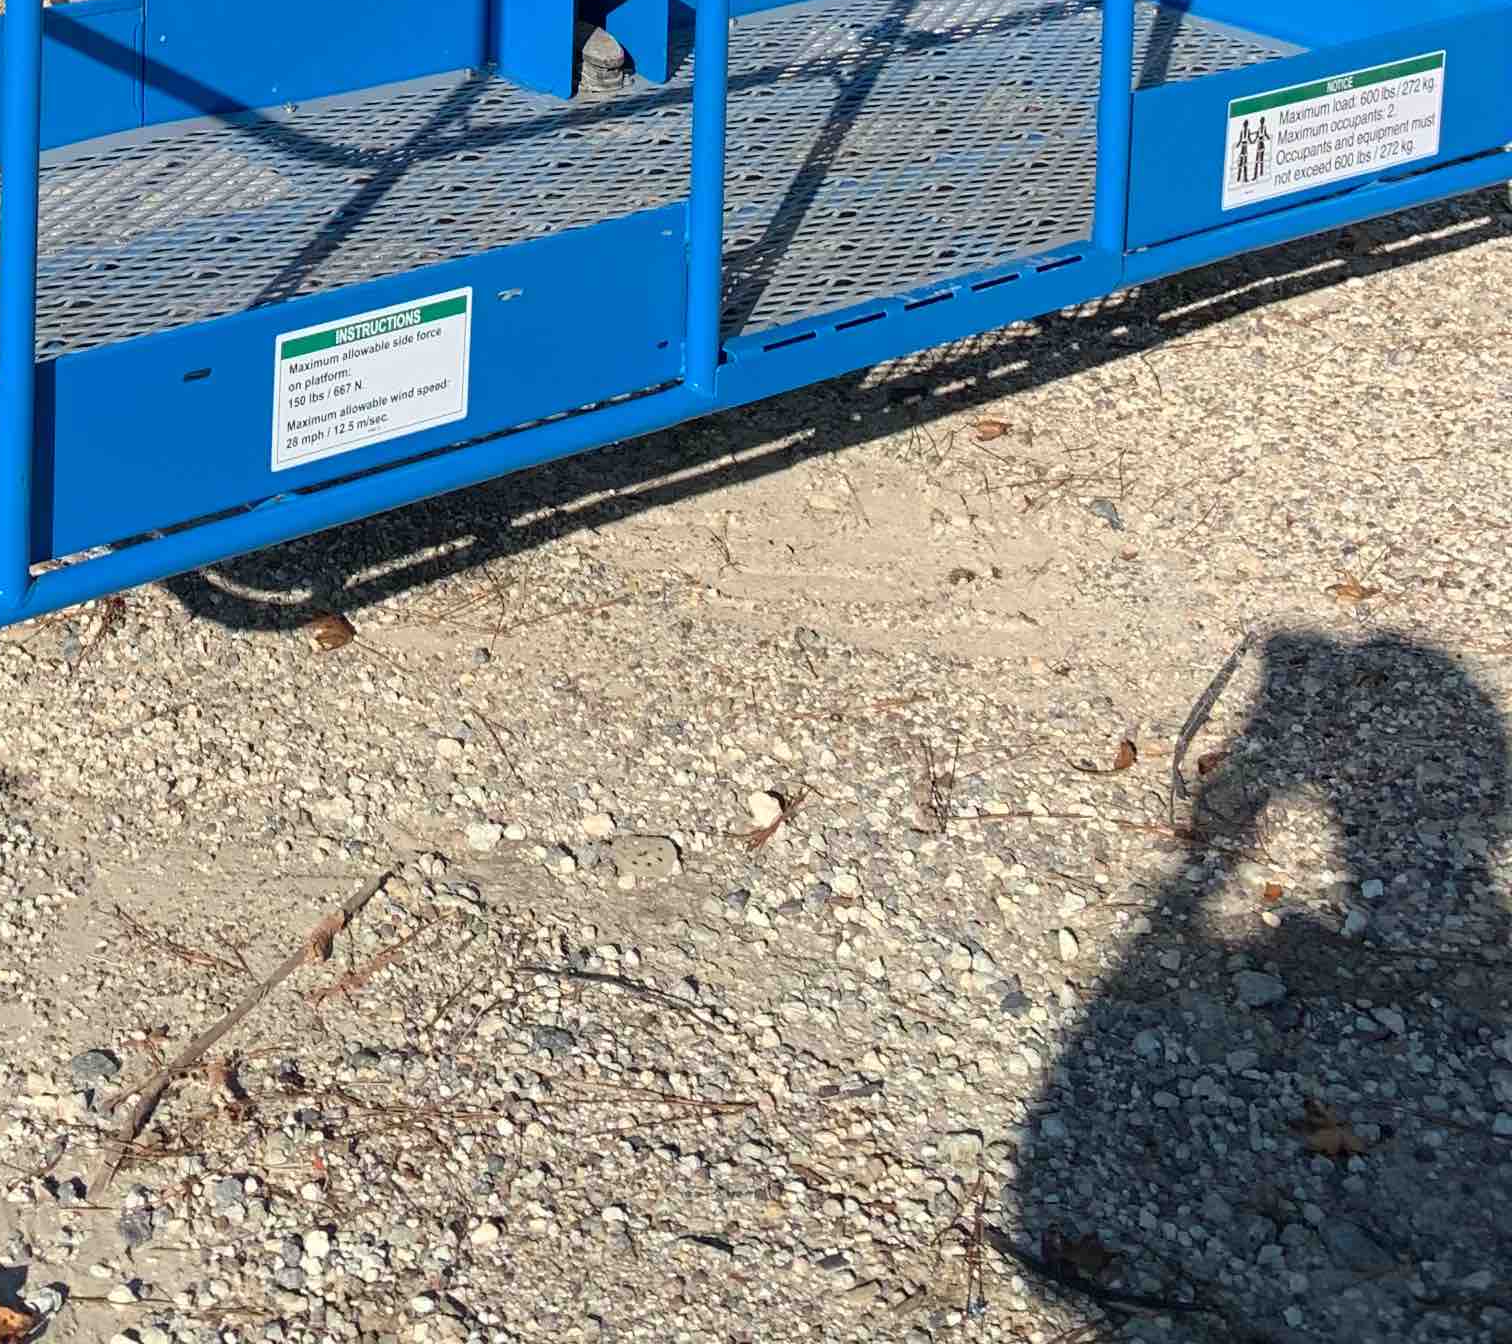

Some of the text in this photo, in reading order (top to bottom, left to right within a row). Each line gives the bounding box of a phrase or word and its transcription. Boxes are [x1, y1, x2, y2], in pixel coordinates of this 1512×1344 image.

[1279, 103, 1330, 126] Maximum
[1360, 88, 1379, 106] 600
[1381, 86, 1395, 101] lbs
[1402, 78, 1420, 96] 272
[1276, 112, 1435, 166] Occupants and equipment must
[1277, 122, 1328, 145] Maximum
[1273, 170, 1291, 186] not
[1294, 160, 1332, 181] exceed
[1335, 152, 1354, 170] 600
[1356, 151, 1371, 164] lbs
[1380, 140, 1399, 159] 272
[335, 308, 422, 345] INSTRUCTIONS
[288, 327, 442, 374] Maximum allowable side force
[288, 368, 351, 392] on platform:
[288, 395, 306, 408] 150
[309, 391, 324, 404] lbs
[333, 384, 352, 397] 667
[287, 411, 337, 432] Maximum
[340, 395, 388, 417] allowable
[390, 386, 414, 403] wind
[286, 436, 299, 449] 28
[301, 431, 324, 446] mph
